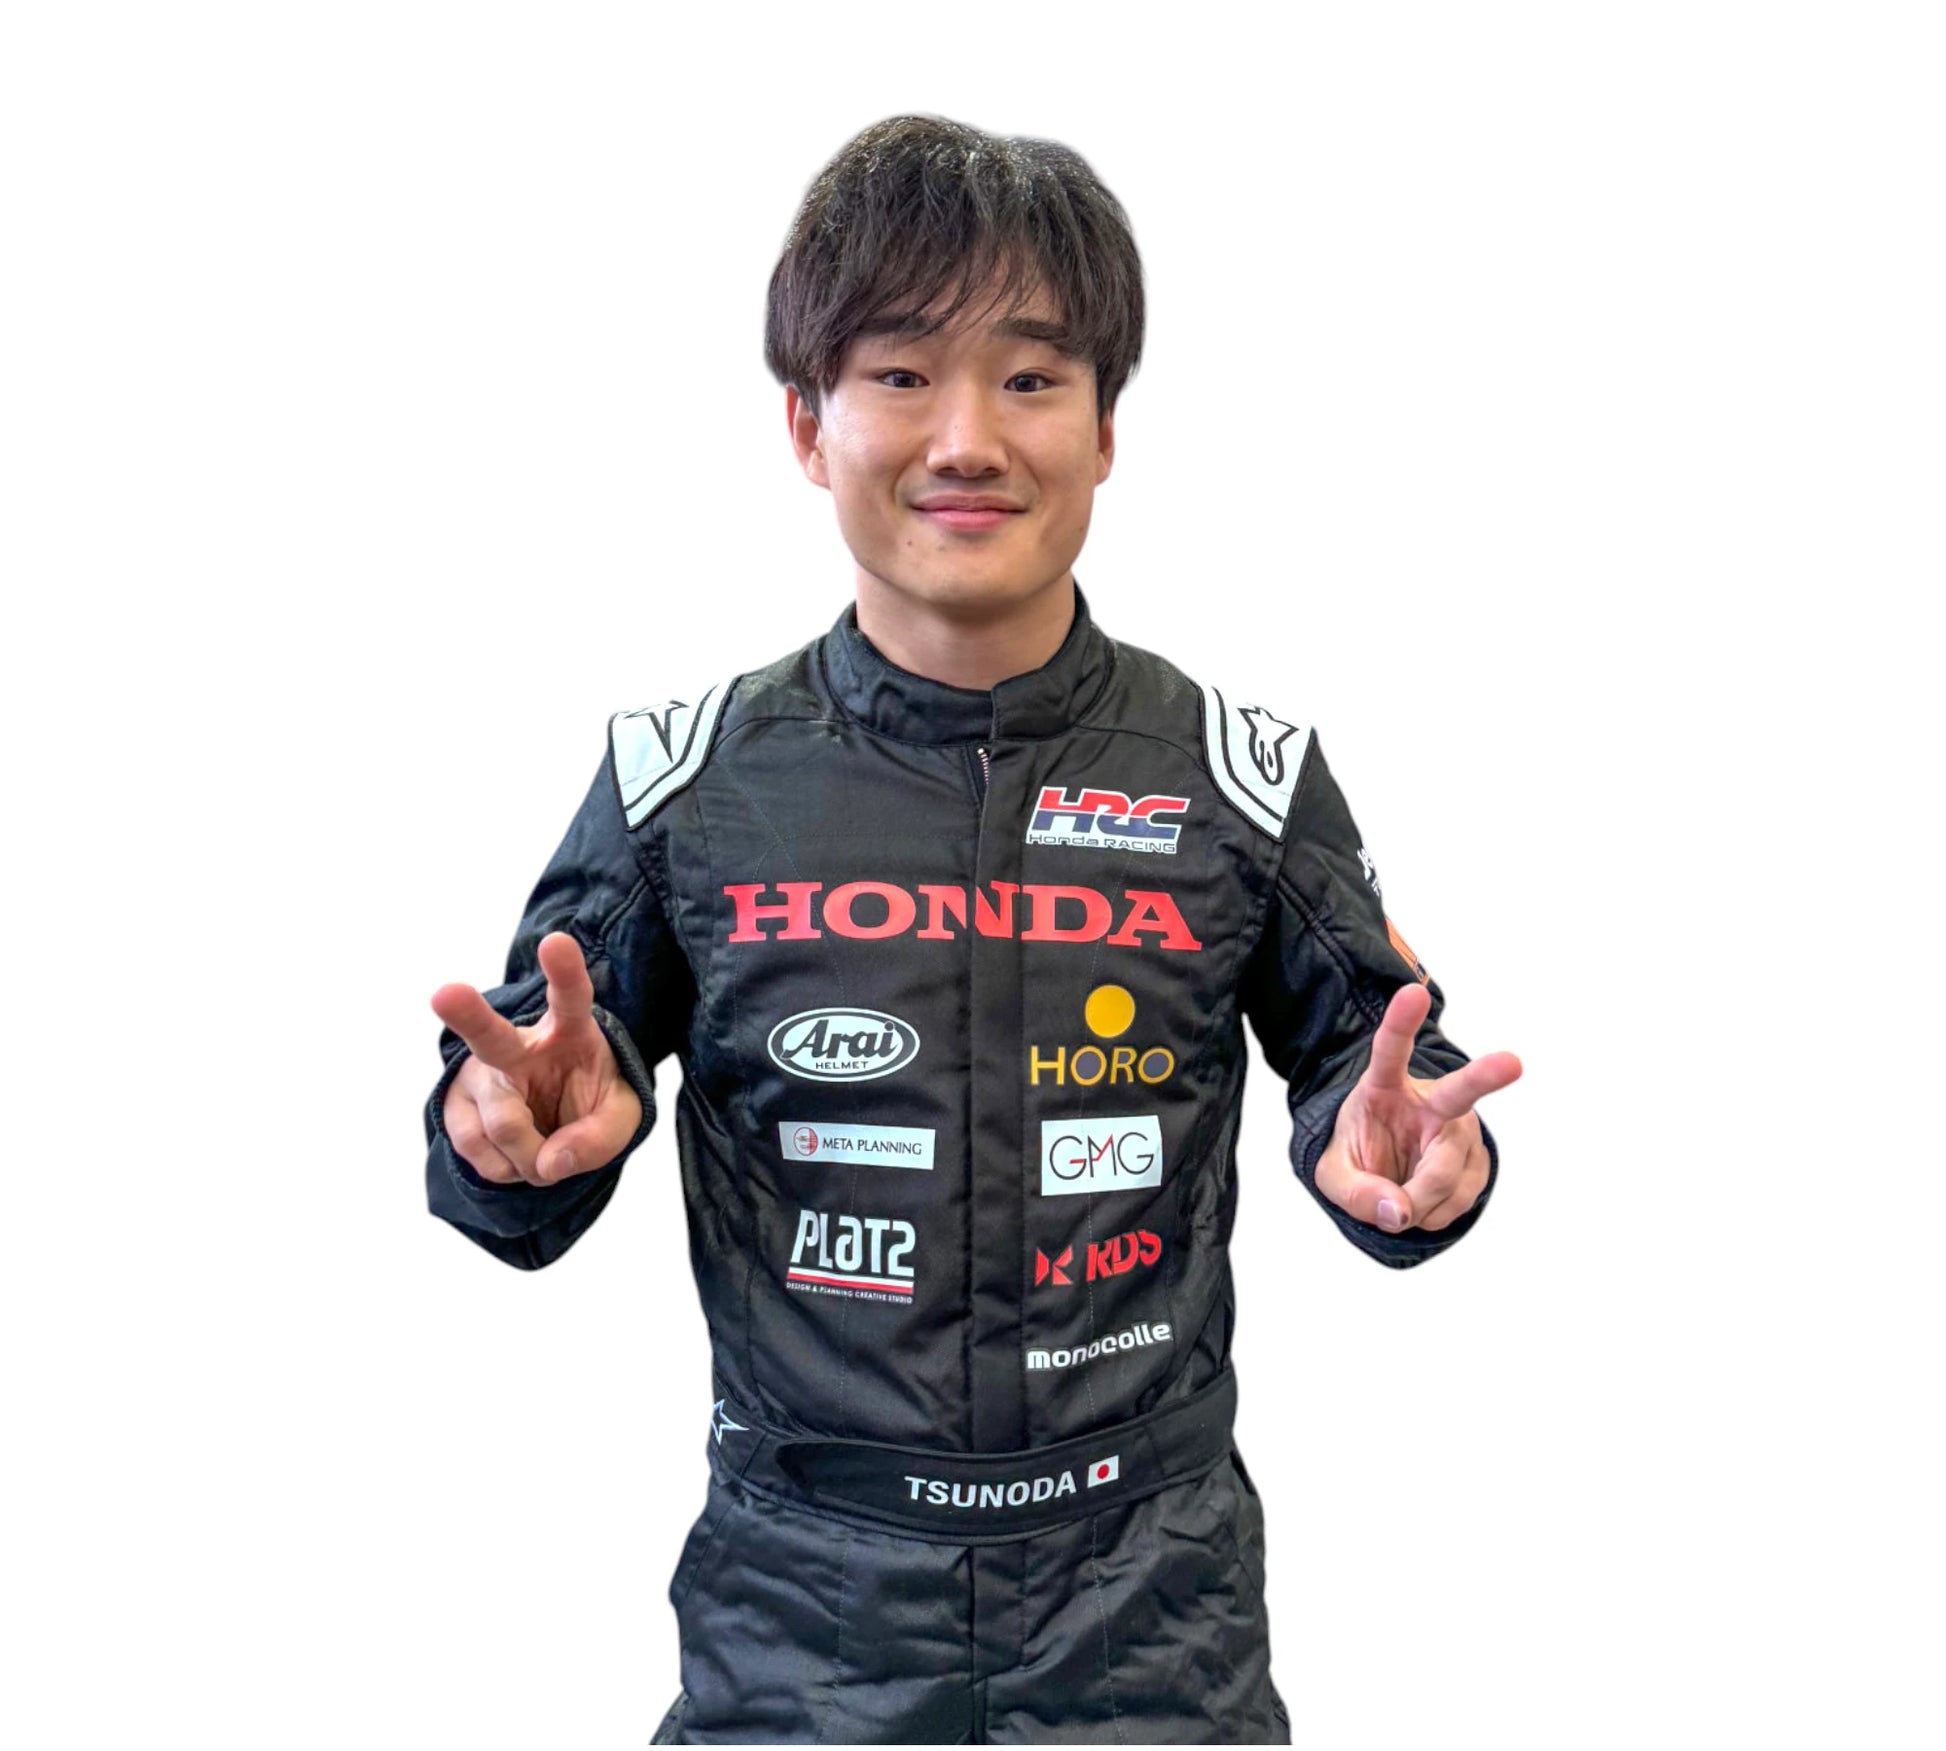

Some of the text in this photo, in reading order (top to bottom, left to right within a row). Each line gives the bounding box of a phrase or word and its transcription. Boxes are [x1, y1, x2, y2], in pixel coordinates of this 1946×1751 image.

[1031, 789, 1187, 839] HRC
[1028, 834, 1176, 853] Honda RACING
[723, 881, 1203, 951] HONDA
[780, 1019, 899, 1059] Arai
[815, 1060, 869, 1070] HELMET
[1030, 1045, 1175, 1086] HORO
[822, 1137, 923, 1156] META PLANNING
[1049, 1131, 1155, 1181] GMG
[786, 1281, 811, 1290] DESIGN
[819, 1285, 853, 1297] PLANNING
[854, 1291, 887, 1301] CREATIVE
[888, 1295, 913, 1304] STUDIO
[904, 1470, 1077, 1508] TSUNODA
